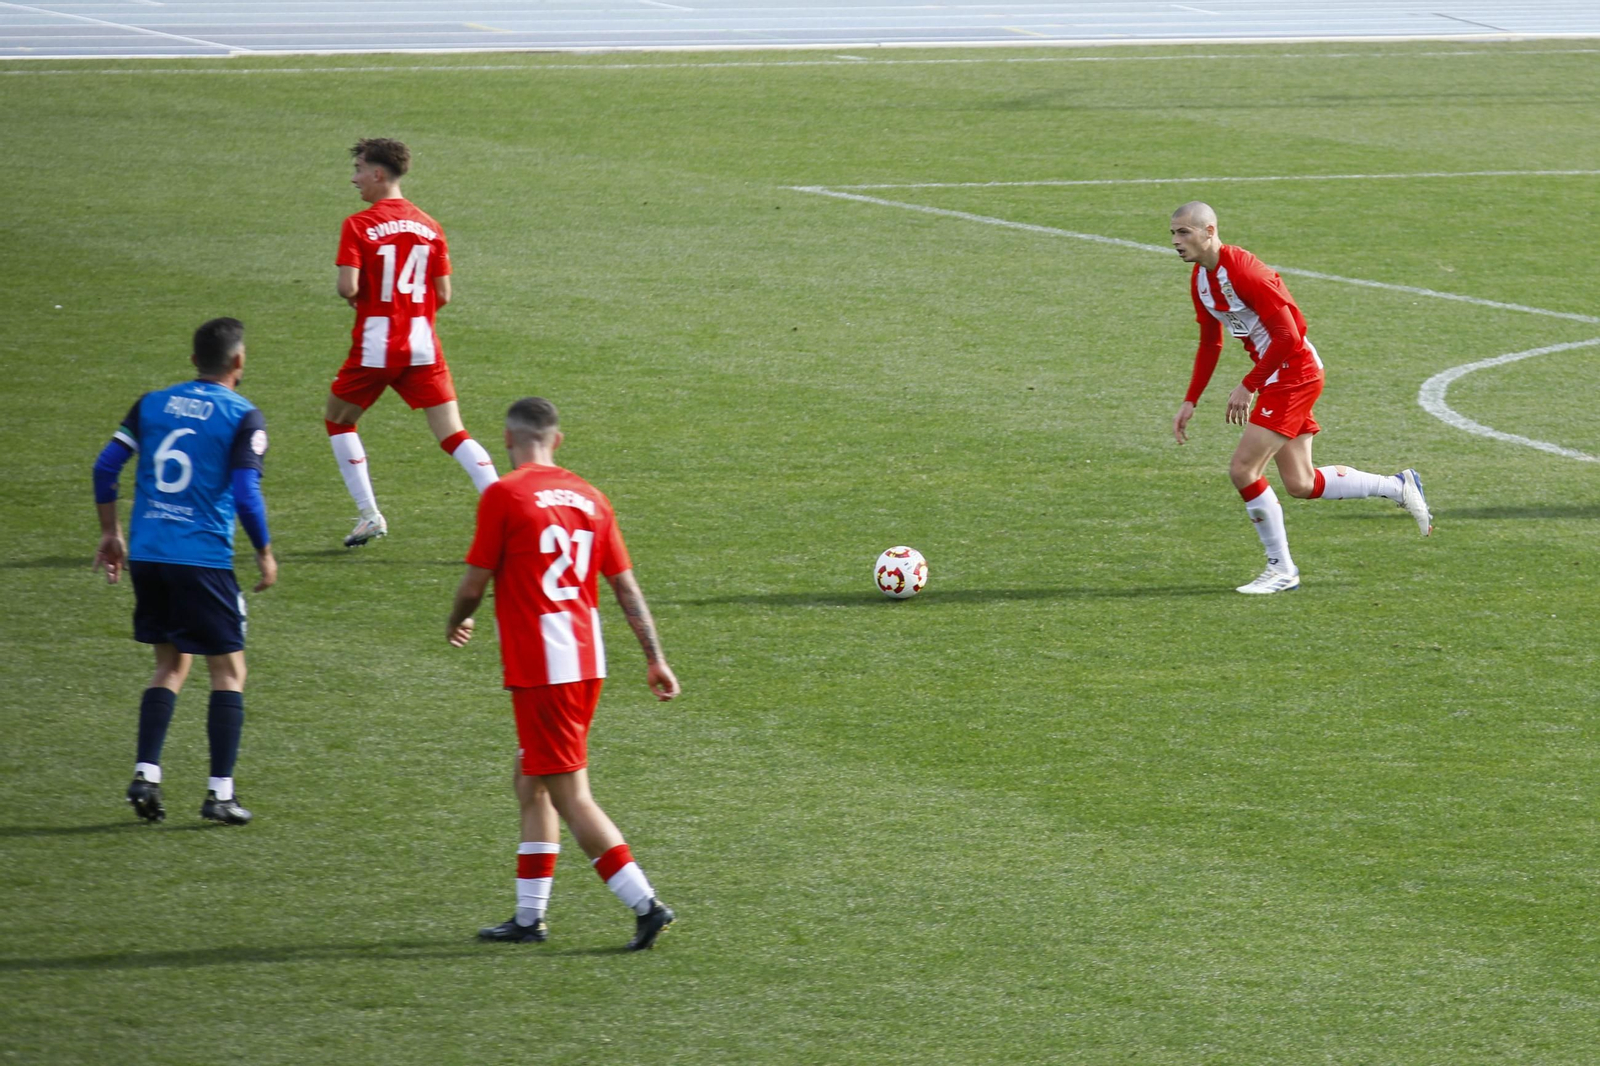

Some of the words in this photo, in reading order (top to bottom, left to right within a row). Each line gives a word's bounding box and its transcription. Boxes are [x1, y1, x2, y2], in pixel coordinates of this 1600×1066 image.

[376, 244, 430, 303] 14
[153, 427, 197, 494] 6
[539, 524, 595, 602] 21
